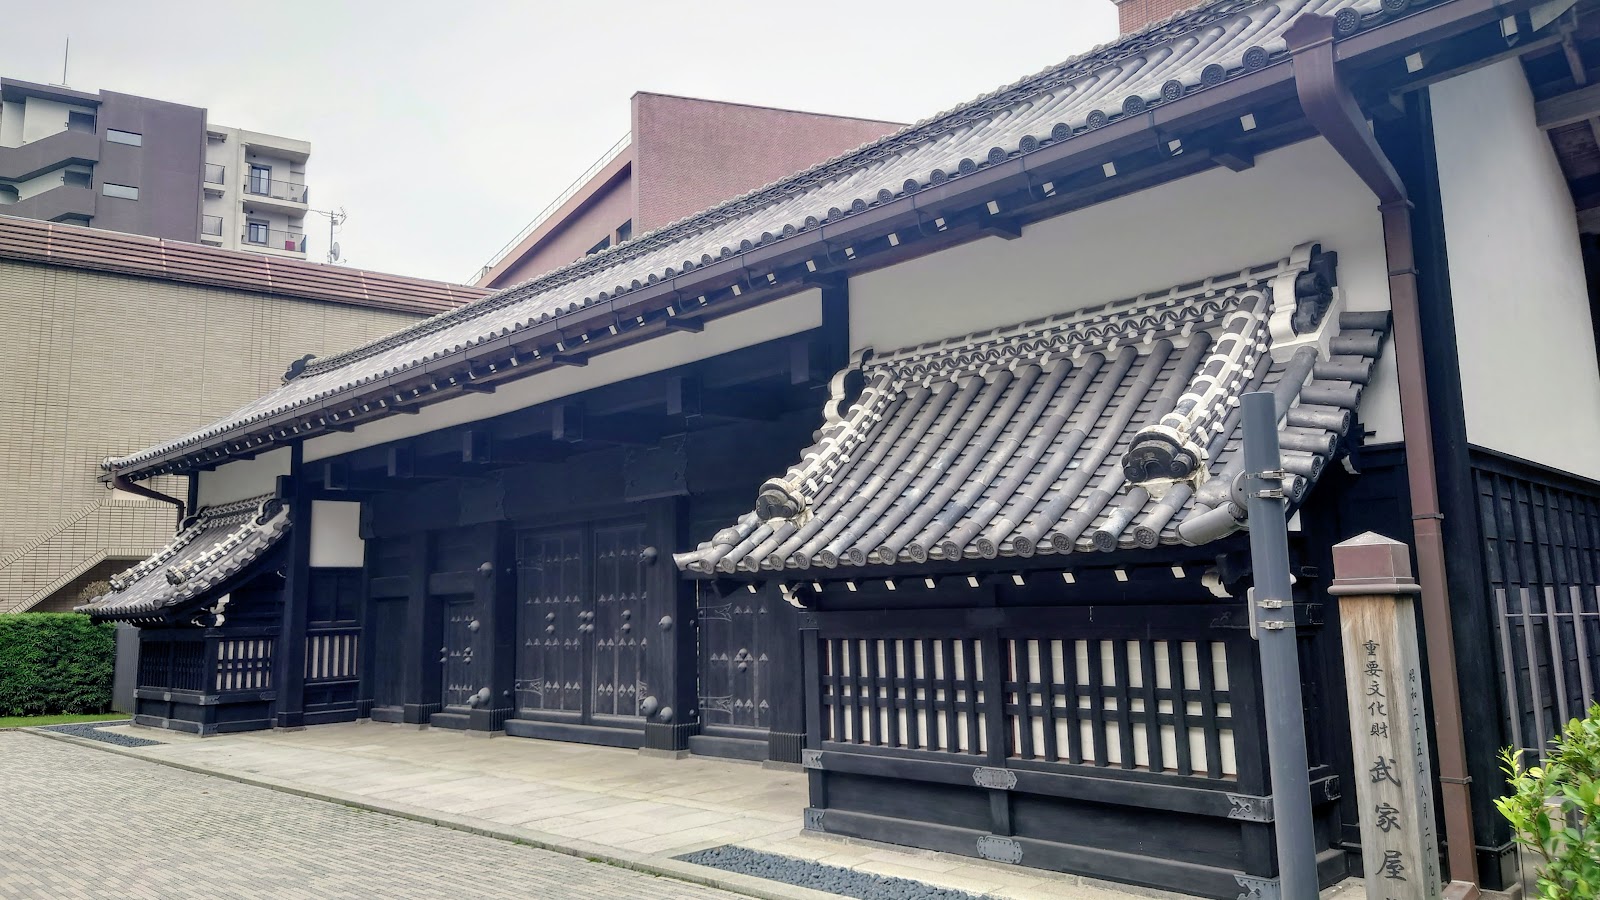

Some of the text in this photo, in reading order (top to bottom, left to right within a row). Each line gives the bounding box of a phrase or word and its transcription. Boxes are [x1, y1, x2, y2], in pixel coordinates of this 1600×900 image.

[1362, 639, 1407, 900] 重要文化財 武家屋
